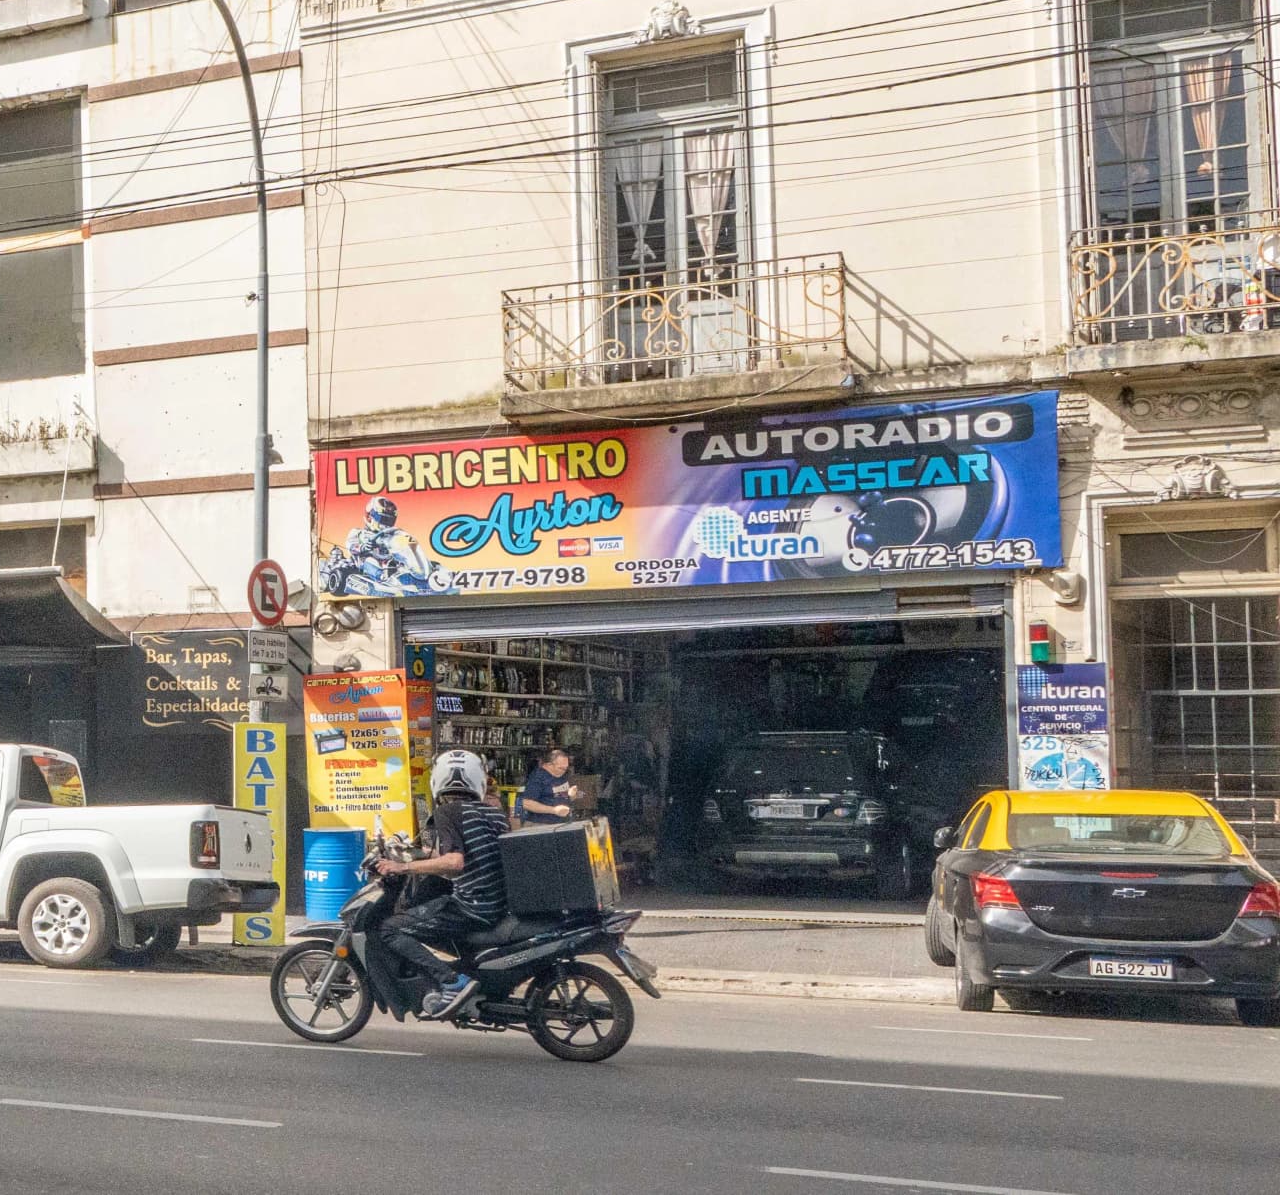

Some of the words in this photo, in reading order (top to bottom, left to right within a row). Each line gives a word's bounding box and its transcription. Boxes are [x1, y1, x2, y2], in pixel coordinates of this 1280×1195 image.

[699, 410, 1014, 461] AUTORADIO
[335, 437, 628, 496] LUBRICENTRO
[741, 451, 992, 499] MASSCAR
[429, 491, 624, 558] Ayrton
[746, 508, 811, 525] AGENTE
[598, 542, 619, 550] VISA
[727, 532, 820, 559] ituran
[869, 539, 1036, 571] 4772-1543
[614, 558, 699, 572] CORDOBA
[454, 566, 586, 590] 4777-9798
[632, 570, 681, 586] 5257
[145, 648, 177, 666] Bar,
[181, 647, 232, 669] Tapas,
[146, 675, 218, 692] Cocktails
[226, 676, 241, 691] &
[1041, 683, 1106, 699] ituran
[145, 697, 251, 718] Especialidades
[1021, 705, 1057, 713] CENTRO
[1059, 704, 1105, 712] INTEGRAL
[1055, 713, 1067, 721] DE
[351, 728, 379, 738] 12x65
[1039, 722, 1082, 730] SERVICIO
[351, 740, 378, 750] 12x75
[1095, 963, 1113, 975] AG
[1117, 963, 1145, 976] 522
[1150, 964, 1169, 977] JV
